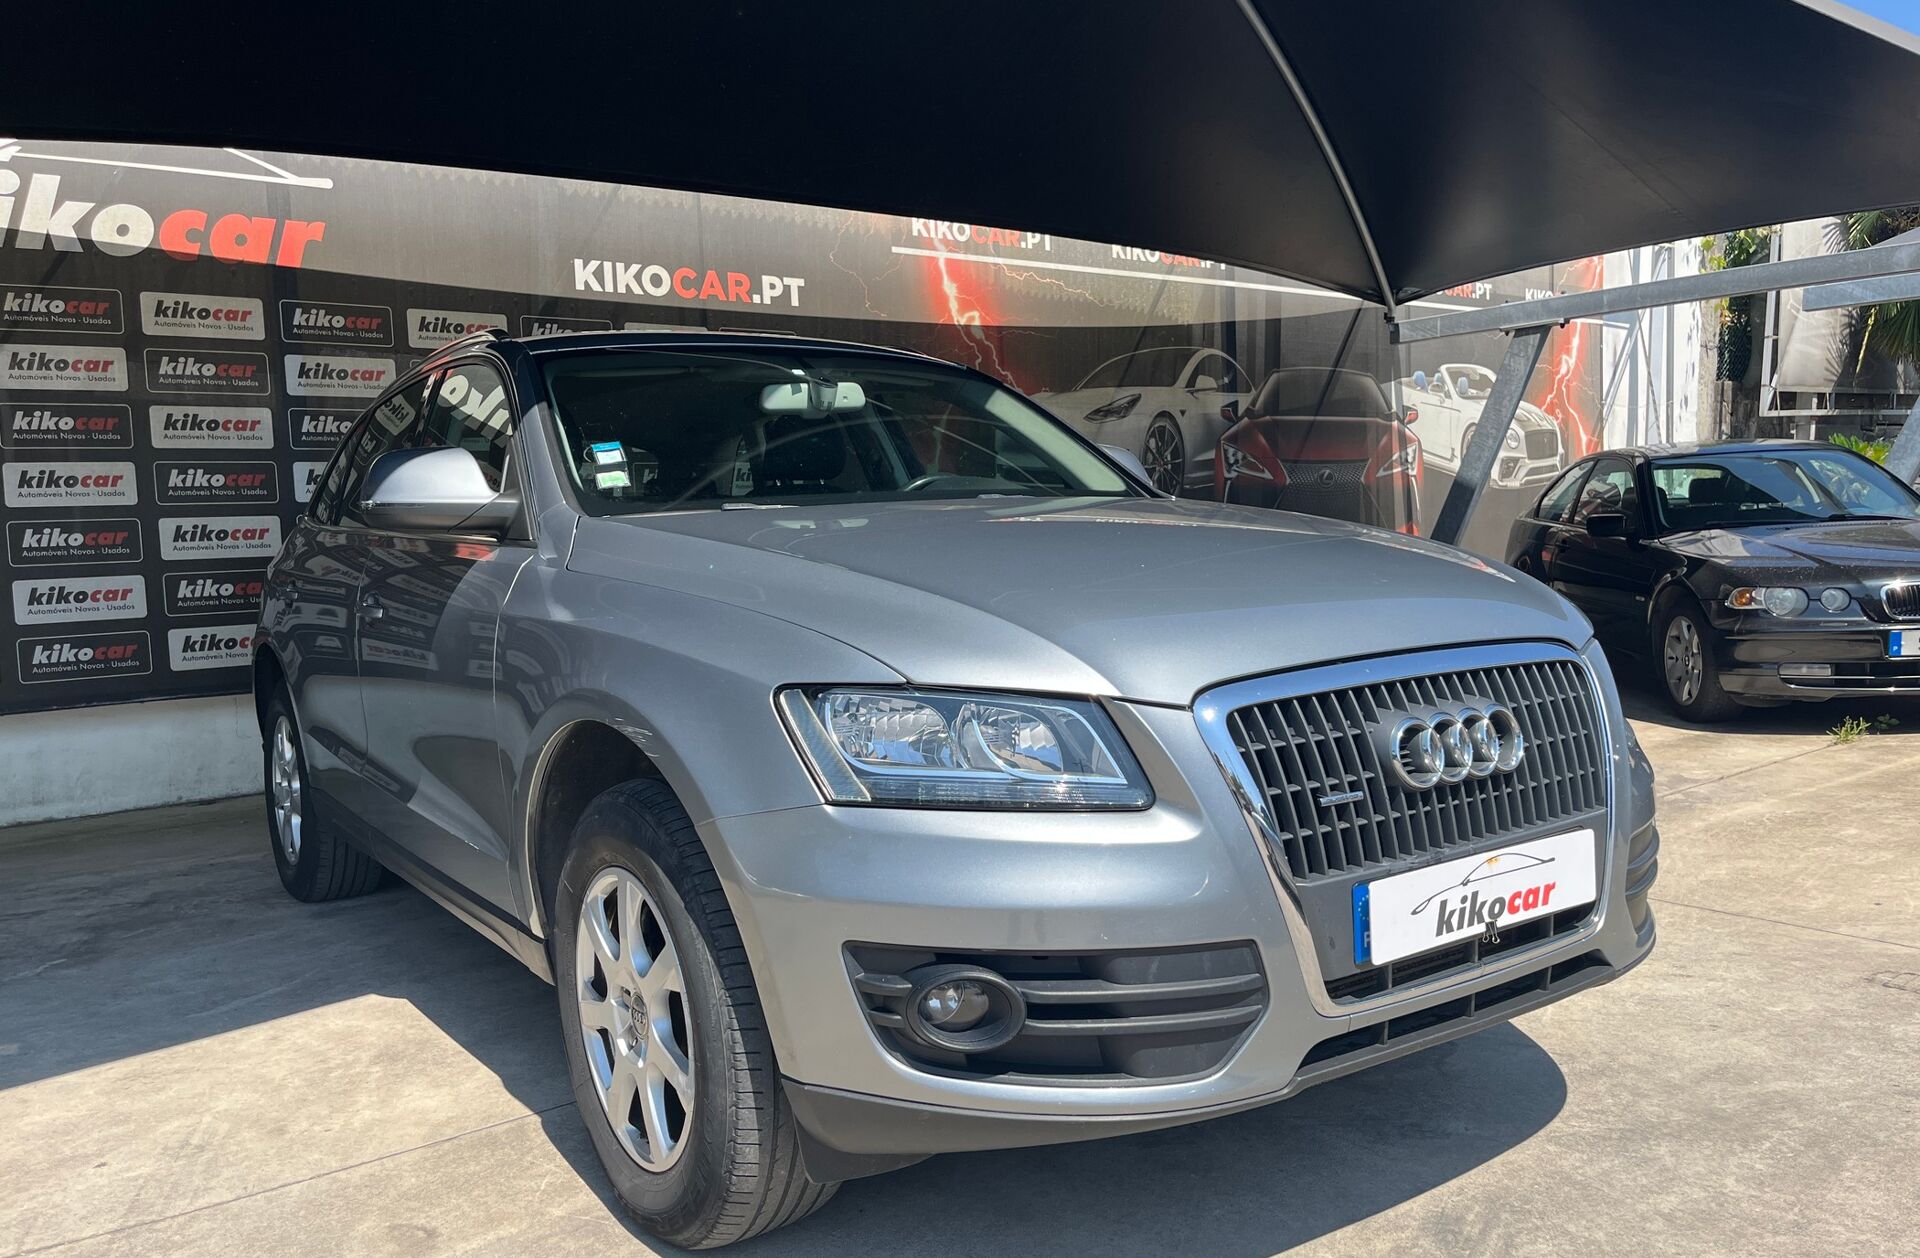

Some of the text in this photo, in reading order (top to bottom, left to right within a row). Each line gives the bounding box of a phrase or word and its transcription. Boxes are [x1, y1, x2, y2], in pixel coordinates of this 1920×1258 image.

[574, 258, 805, 307] KIKOCAR.PT
[4, 292, 110, 315] kikocar
[154, 300, 253, 322] kikocar
[4, 314, 49, 322] Automóveis
[83, 317, 112, 325] Usados
[154, 321, 196, 329] Automóveis
[199, 322, 222, 330] Novos
[228, 324, 254, 332] Usados
[293, 308, 382, 330] kikocar
[419, 316, 498, 335] kikoca
[293, 327, 331, 336] Automóveis
[333, 329, 355, 337] Novos
[360, 331, 384, 339] Usados
[8, 352, 115, 373] kikocar
[159, 357, 257, 378] kikocar
[88, 375, 116, 383] Usados
[298, 362, 386, 382] kikocar
[159, 377, 201, 385] Automóveis
[203, 378, 226, 386] Novos
[233, 379, 259, 387] Usados
[298, 381, 336, 389] Automóveis
[13, 411, 119, 431] kikocar
[164, 413, 262, 432] kikocar
[13, 432, 58, 440] Automóveis
[164, 433, 206, 441] Automóveis
[208, 433, 231, 441] Novos
[237, 433, 263, 441] Usados
[18, 470, 124, 489] kikocar
[168, 469, 266, 488] kikocar
[18, 490, 63, 498] Automóveis
[66, 490, 91, 498] Novos
[168, 488, 211, 496] Automóveis
[213, 488, 236, 496] Novos
[22, 528, 129, 548] kikocar
[173, 525, 270, 543] kikocar
[22, 549, 68, 558] Automóveis
[173, 544, 215, 552] Automóveis
[246, 542, 272, 550] Usados
[28, 586, 134, 606] kikocar
[178, 600, 219, 608] Automóveis
[27, 607, 73, 616] Automóveis
[107, 603, 135, 611] Usados
[32, 644, 138, 665] kikocar
[32, 665, 78, 674] Automóveis
[112, 660, 140, 668] Usados
[1435, 881, 1556, 938] kikocar
